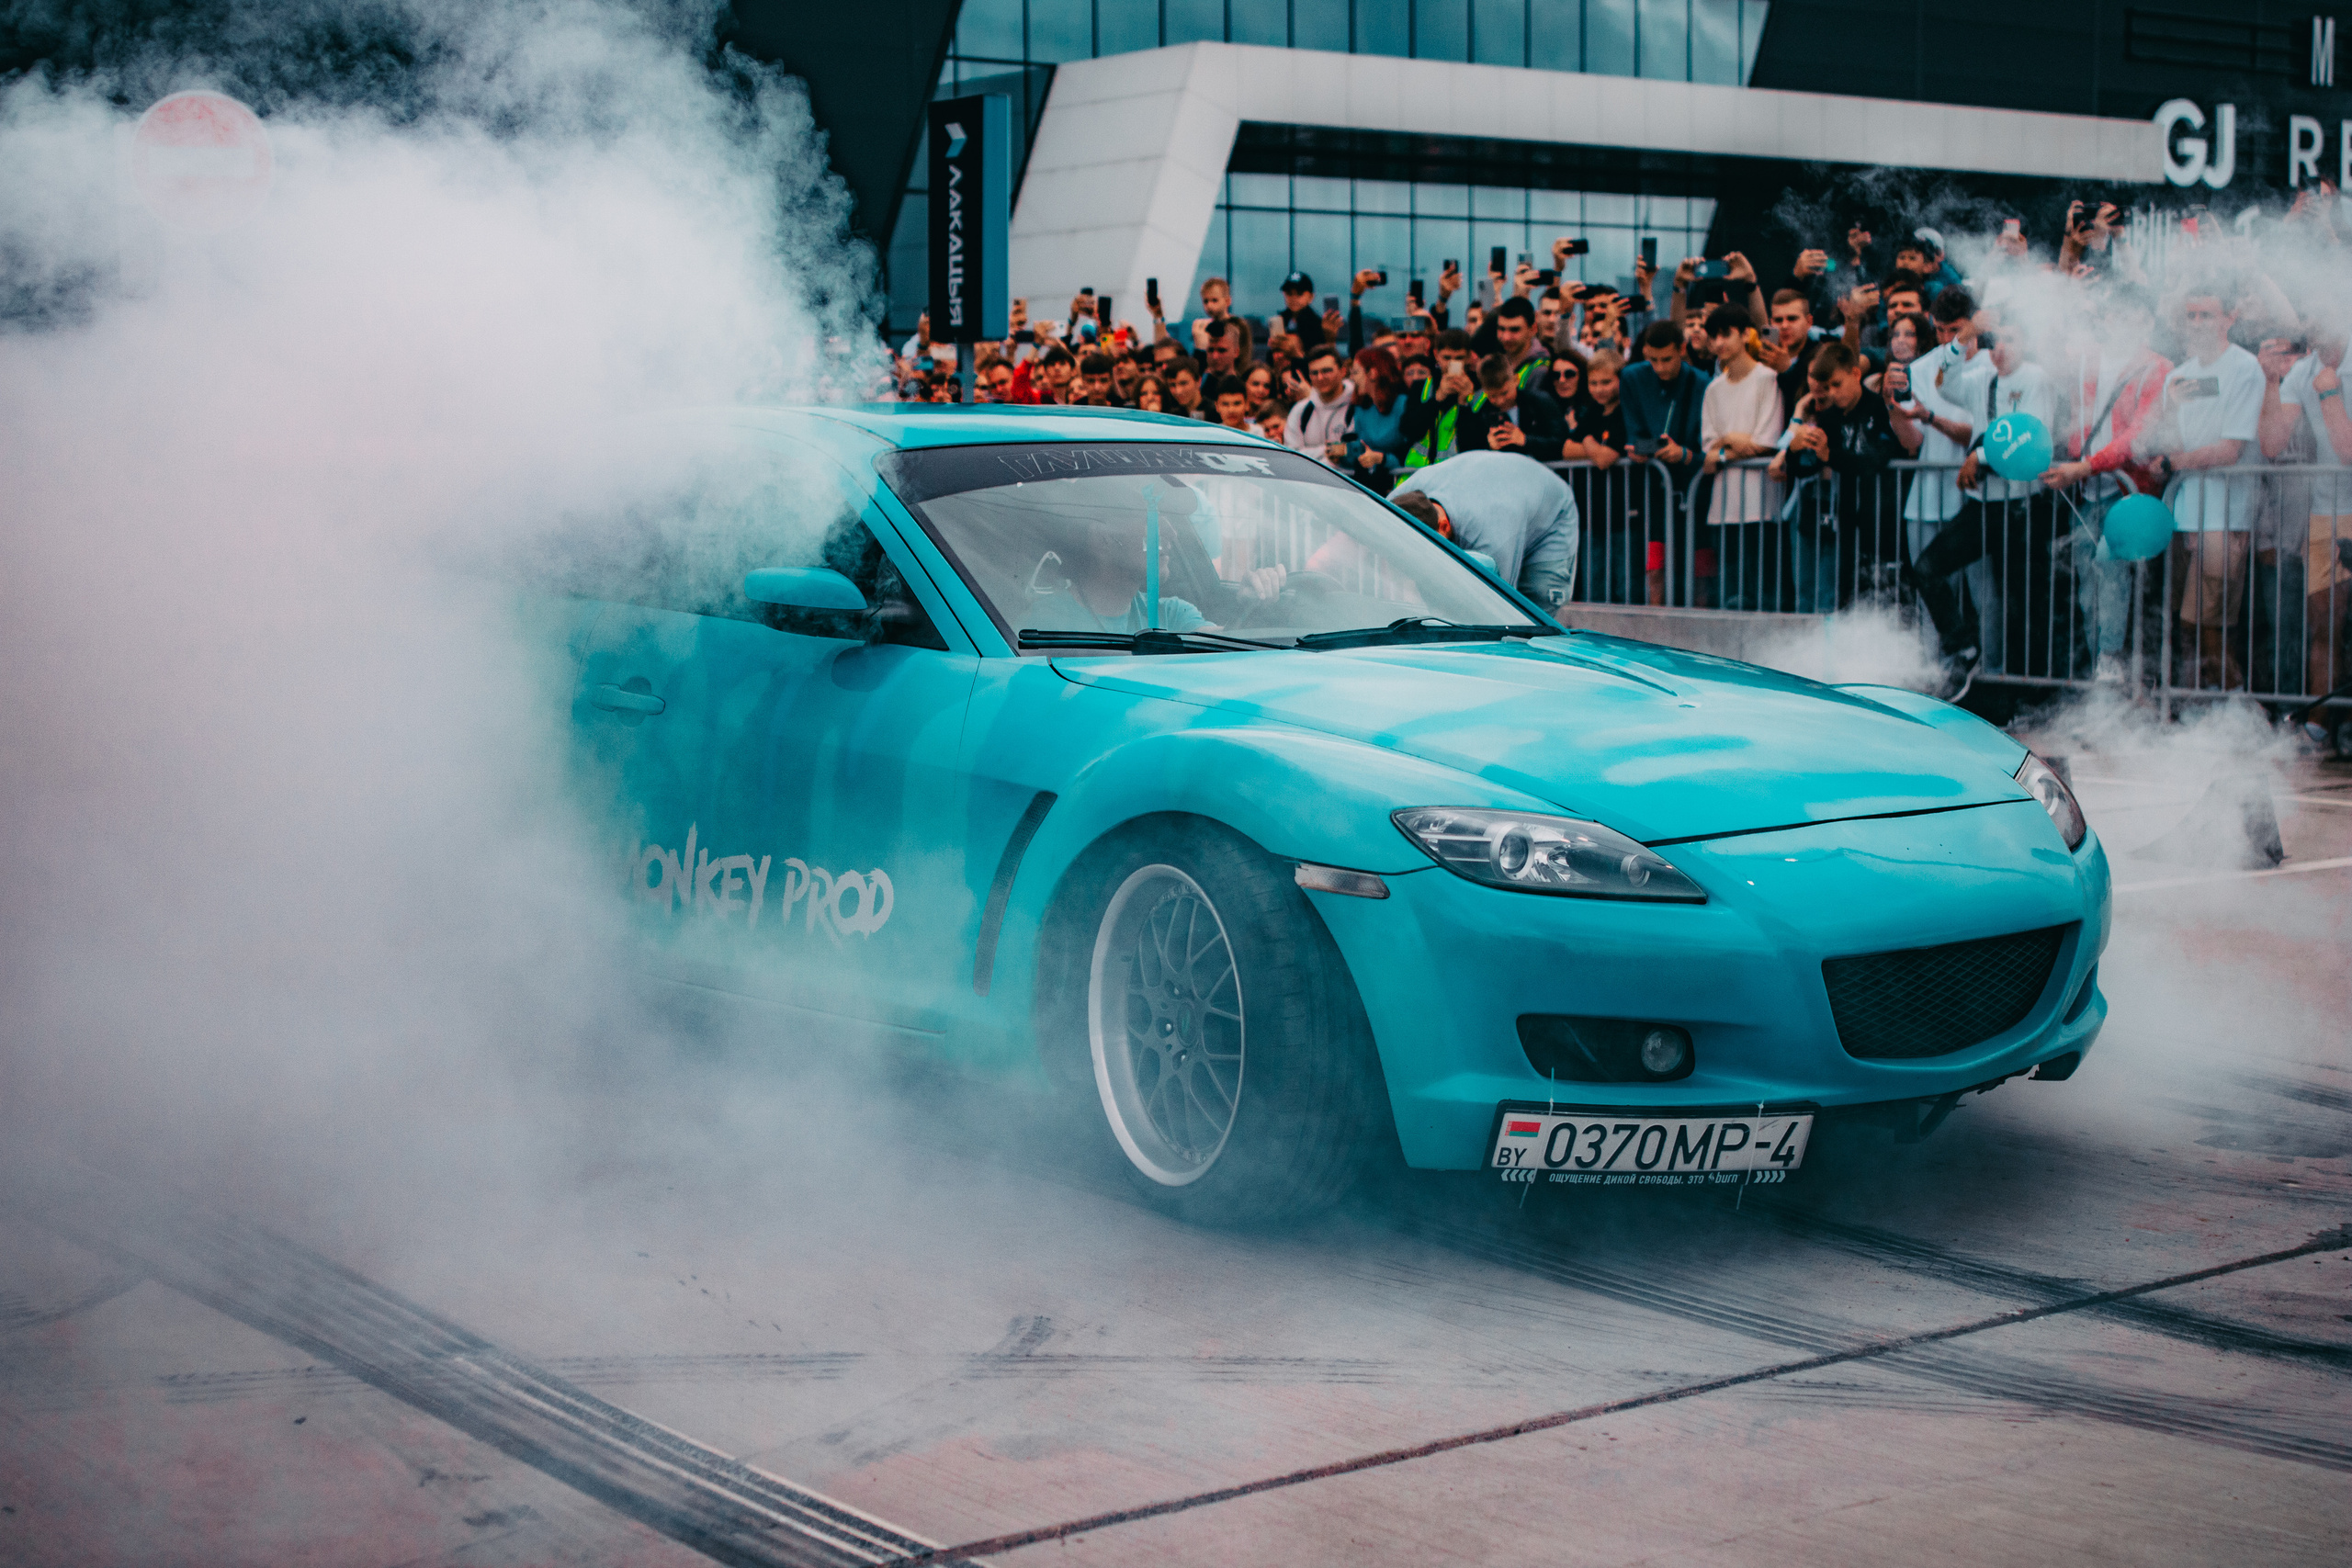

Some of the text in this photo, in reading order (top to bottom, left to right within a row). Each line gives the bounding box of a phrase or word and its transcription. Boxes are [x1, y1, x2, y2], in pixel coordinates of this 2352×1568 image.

[782, 857, 894, 950] PROD
[1497, 1146, 1527, 1167] BY
[1548, 1171, 1738, 1186] ОЩУЩЕНИЕ ДИКОЙ СВОБОДЫ. ЭТО burn
